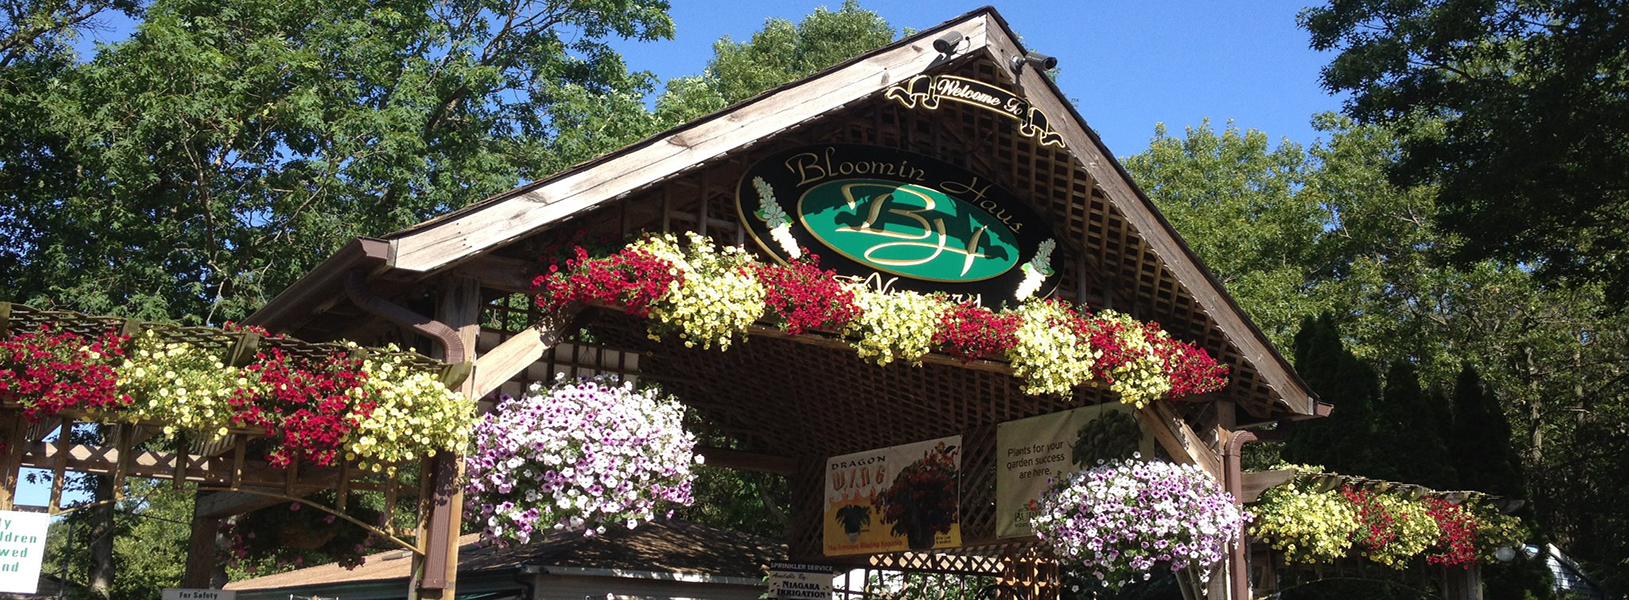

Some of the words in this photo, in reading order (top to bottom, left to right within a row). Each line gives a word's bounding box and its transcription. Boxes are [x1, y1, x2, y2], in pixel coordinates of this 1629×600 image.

[936, 75, 1001, 107] Welcome
[1003, 97, 1024, 117] To
[785, 146, 926, 188] Bloomin
[939, 175, 1024, 234] Haus
[1007, 445, 1031, 458] Plants
[1033, 442, 1045, 454] for
[1045, 441, 1064, 455] your
[831, 455, 886, 470] DRAGON
[1006, 455, 1034, 471] garden
[1034, 452, 1065, 466] success
[1019, 470, 1032, 480] are
[1033, 467, 1052, 478] here.
[770, 562, 807, 570] SPRINKLER
[807, 564, 833, 572] SERVICE
[782, 581, 820, 591] NIAGARA
[179, 591, 191, 599] For
[193, 591, 218, 600] Safety
[776, 588, 826, 599] IRRIGATION
